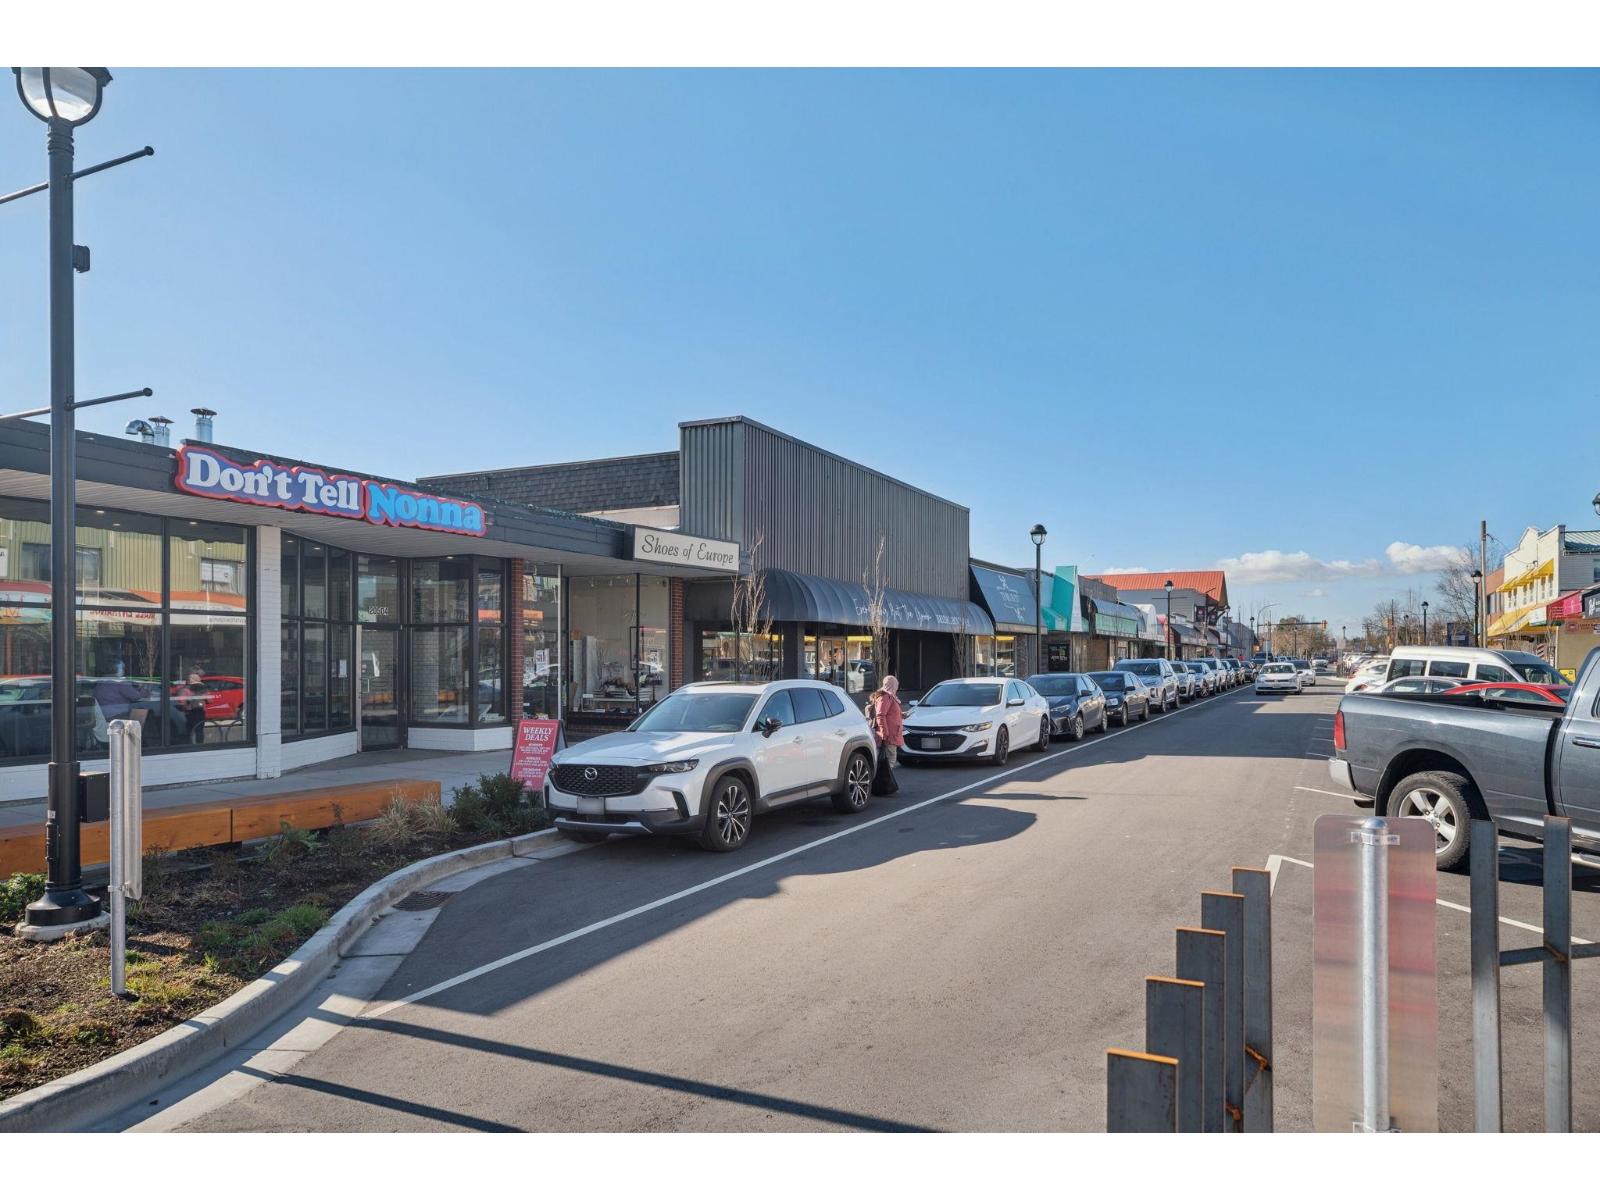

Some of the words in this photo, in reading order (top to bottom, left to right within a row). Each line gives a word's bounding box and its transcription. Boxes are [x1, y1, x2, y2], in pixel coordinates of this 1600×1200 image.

[186, 451, 293, 500] Don't
[298, 473, 361, 511] Tell
[366, 483, 482, 531] Nonna
[641, 534, 680, 557] Shoes
[683, 543, 694, 561] of
[697, 542, 734, 567] Europe
[523, 726, 554, 735] WEEKLY
[524, 733, 550, 742] DEALS
